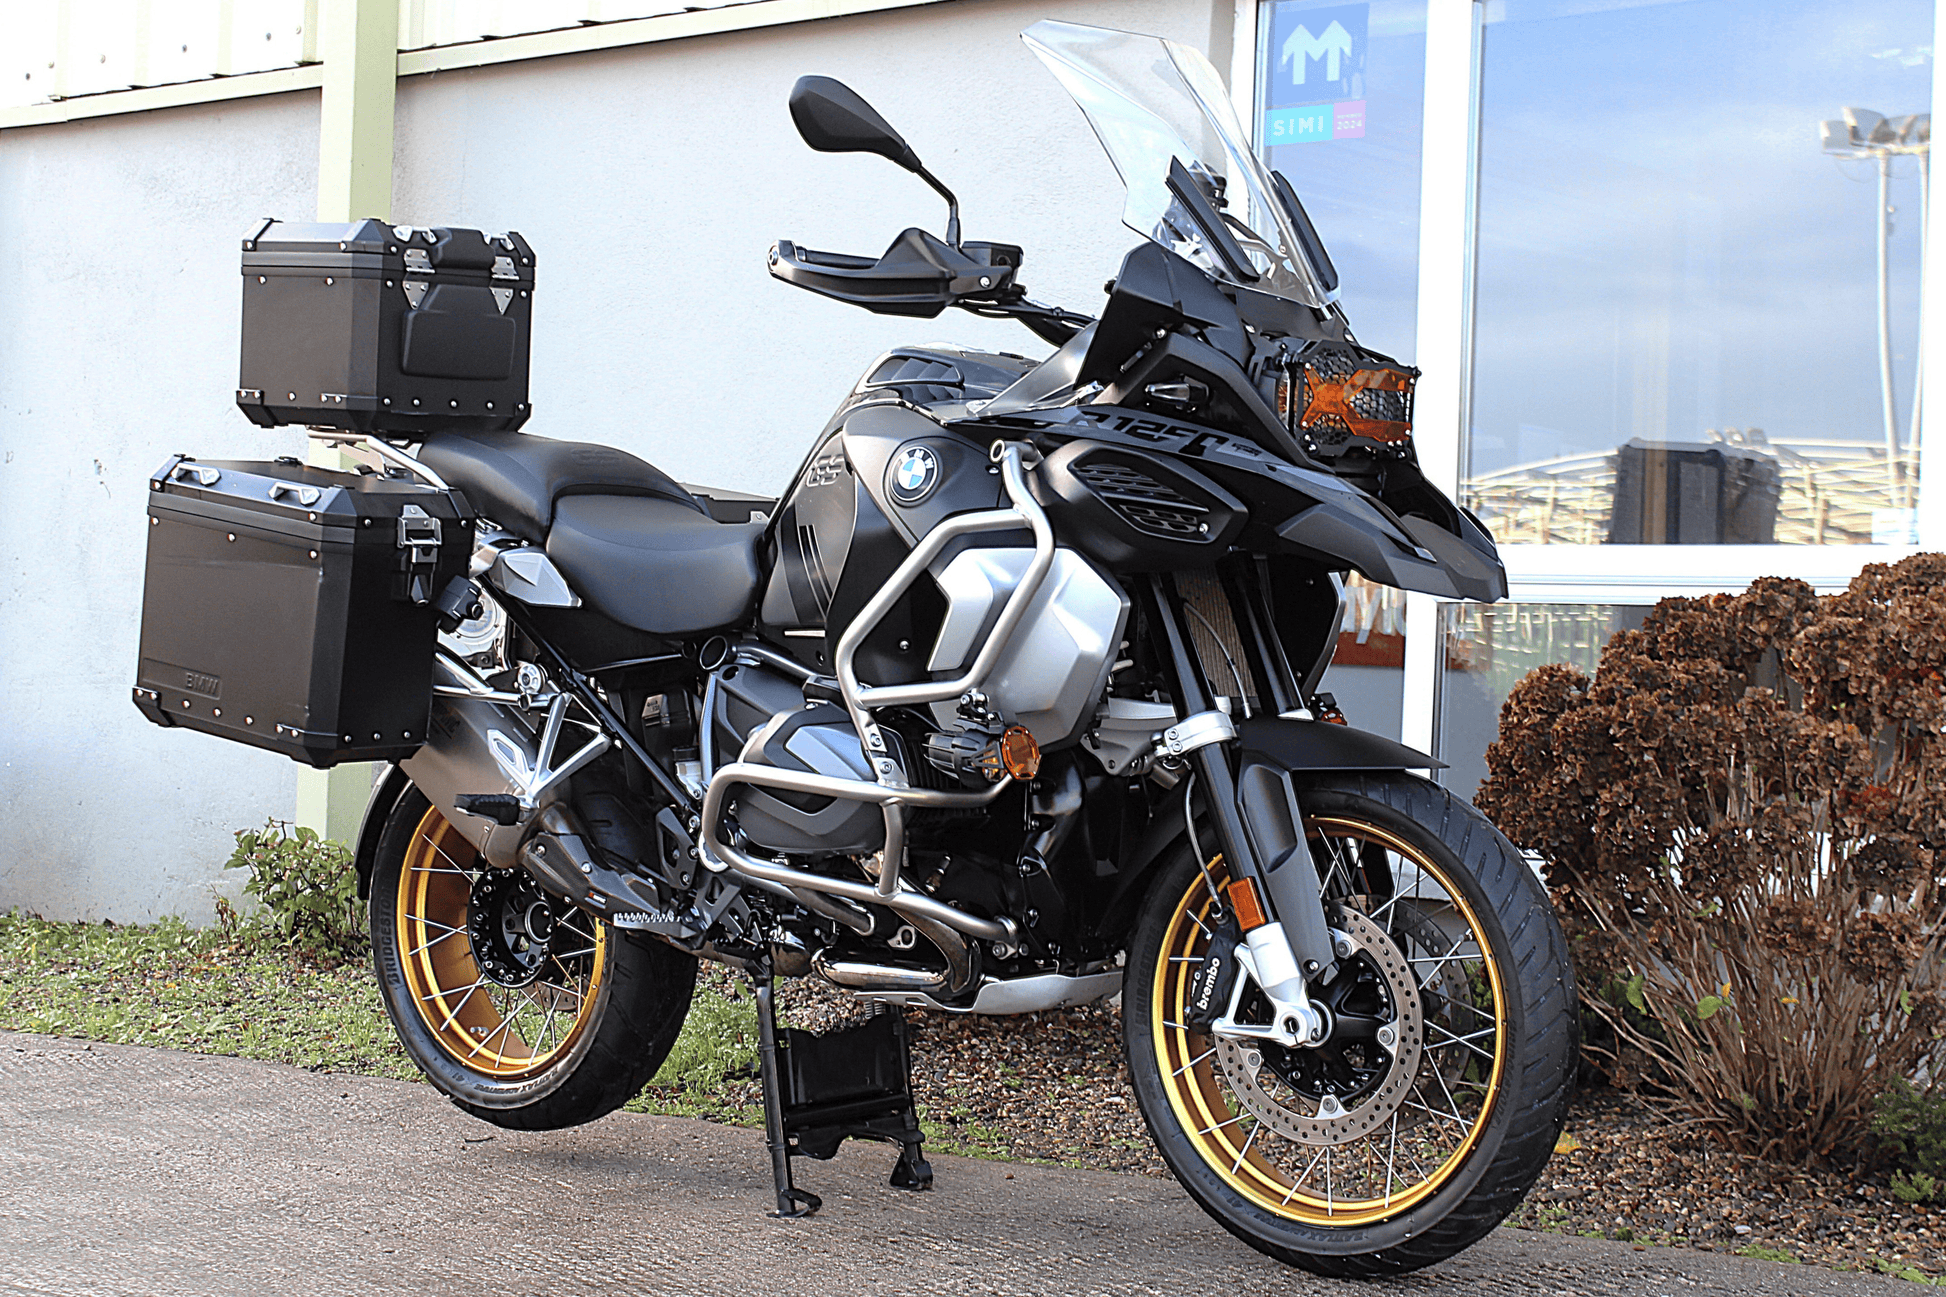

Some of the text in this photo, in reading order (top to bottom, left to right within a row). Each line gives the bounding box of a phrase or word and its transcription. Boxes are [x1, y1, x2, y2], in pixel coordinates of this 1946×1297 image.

[1273, 115, 1324, 137] SIMI
[1336, 119, 1363, 130] 2024
[806, 453, 844, 488] GS
[899, 448, 935, 470] BMW
[185, 671, 219, 695] BMW
[380, 883, 401, 986] BRIDGESTON
[1196, 957, 1221, 1011] brembo
